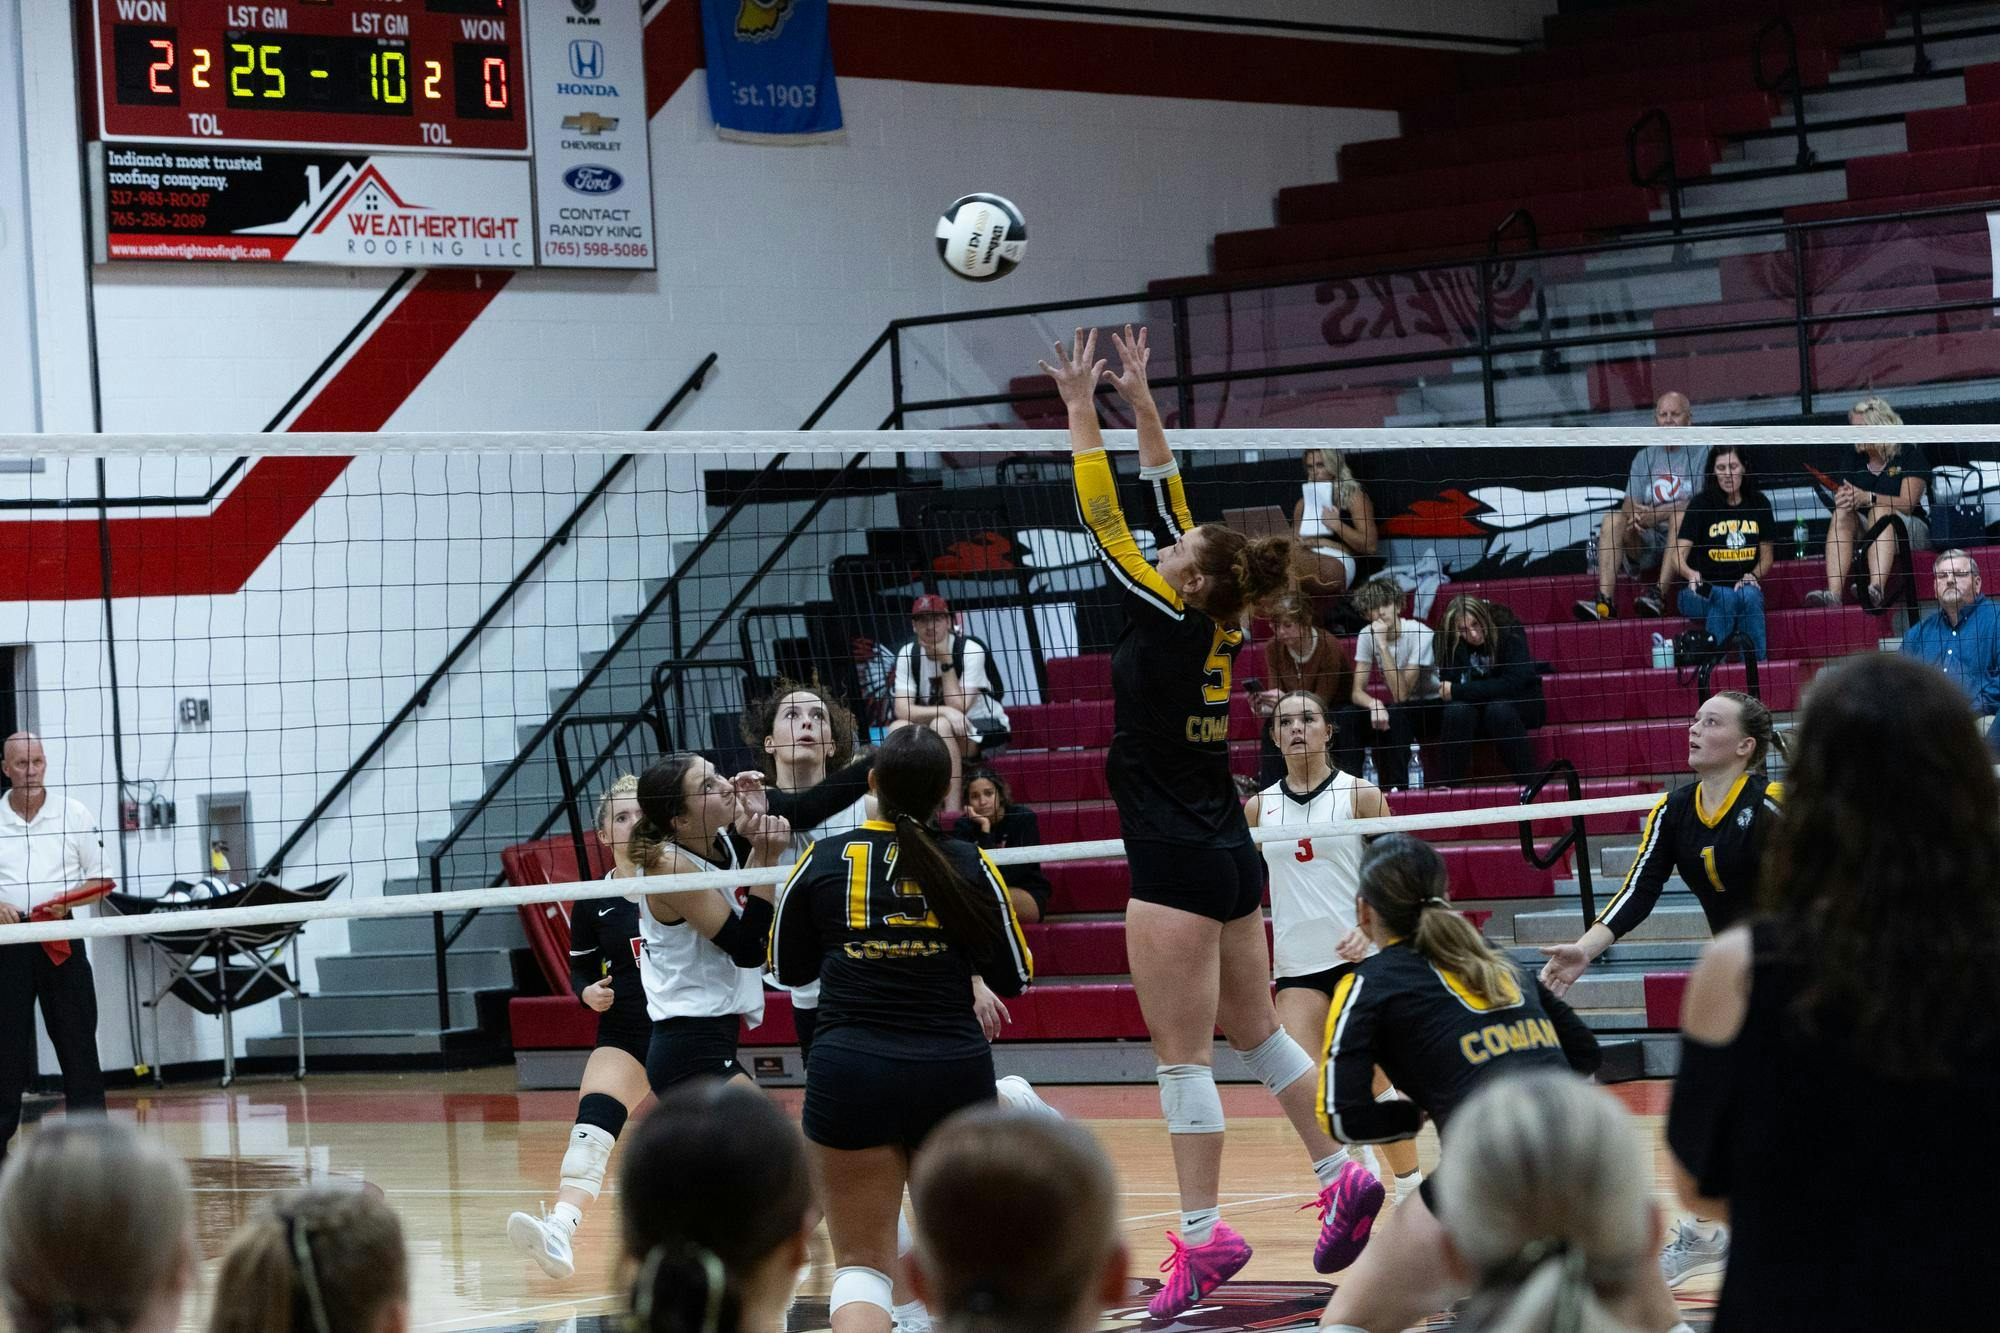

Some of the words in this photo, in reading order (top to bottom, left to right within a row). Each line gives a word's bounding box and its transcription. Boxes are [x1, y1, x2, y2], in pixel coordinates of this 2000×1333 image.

[117, 0, 166, 22] WON
[228, 6, 258, 27] LST
[262, 8, 288, 29] GM
[566, 16, 601, 26] RAM
[352, 12, 381, 33] LST
[384, 14, 409, 36] GM
[461, 19, 505, 41] WON
[150, 40, 174, 93] 2
[192, 49, 211, 87] 2
[231, 44, 286, 98] 25
[370, 52, 406, 103] 10
[424, 61, 441, 98] 2
[484, 57, 507, 108] 0
[557, 83, 620, 97] HONDA
[766, 83, 817, 108] 1903
[188, 113, 223, 136] TOL
[420, 123, 452, 144] TOL
[561, 140, 621, 151] CHEVROLET
[108, 151, 173, 168] Indiana's
[176, 155, 210, 169] most
[214, 156, 262, 171] trusted
[109, 169, 160, 189] roofing
[162, 173, 229, 191] company.
[574, 167, 613, 190] Ford
[111, 191, 210, 208] 317-983-ROOF
[112, 212, 207, 228] 765-256-2089
[560, 208, 631, 221] CONTACT
[348, 214, 519, 239] WEATHERTIGHT
[550, 224, 603, 237] RANDY
[607, 226, 642, 238] KING
[111, 244, 271, 260] www.weathertightroofingllc.com
[348, 239, 463, 256] ROOFING
[484, 242, 522, 258] LLC
[545, 241, 580, 257] (765)
[584, 242, 648, 257] 598-5086
[1201, 623, 1243, 705] 5
[1700, 845, 1726, 892] 1
[1459, 1018, 1562, 1065] COWAN
